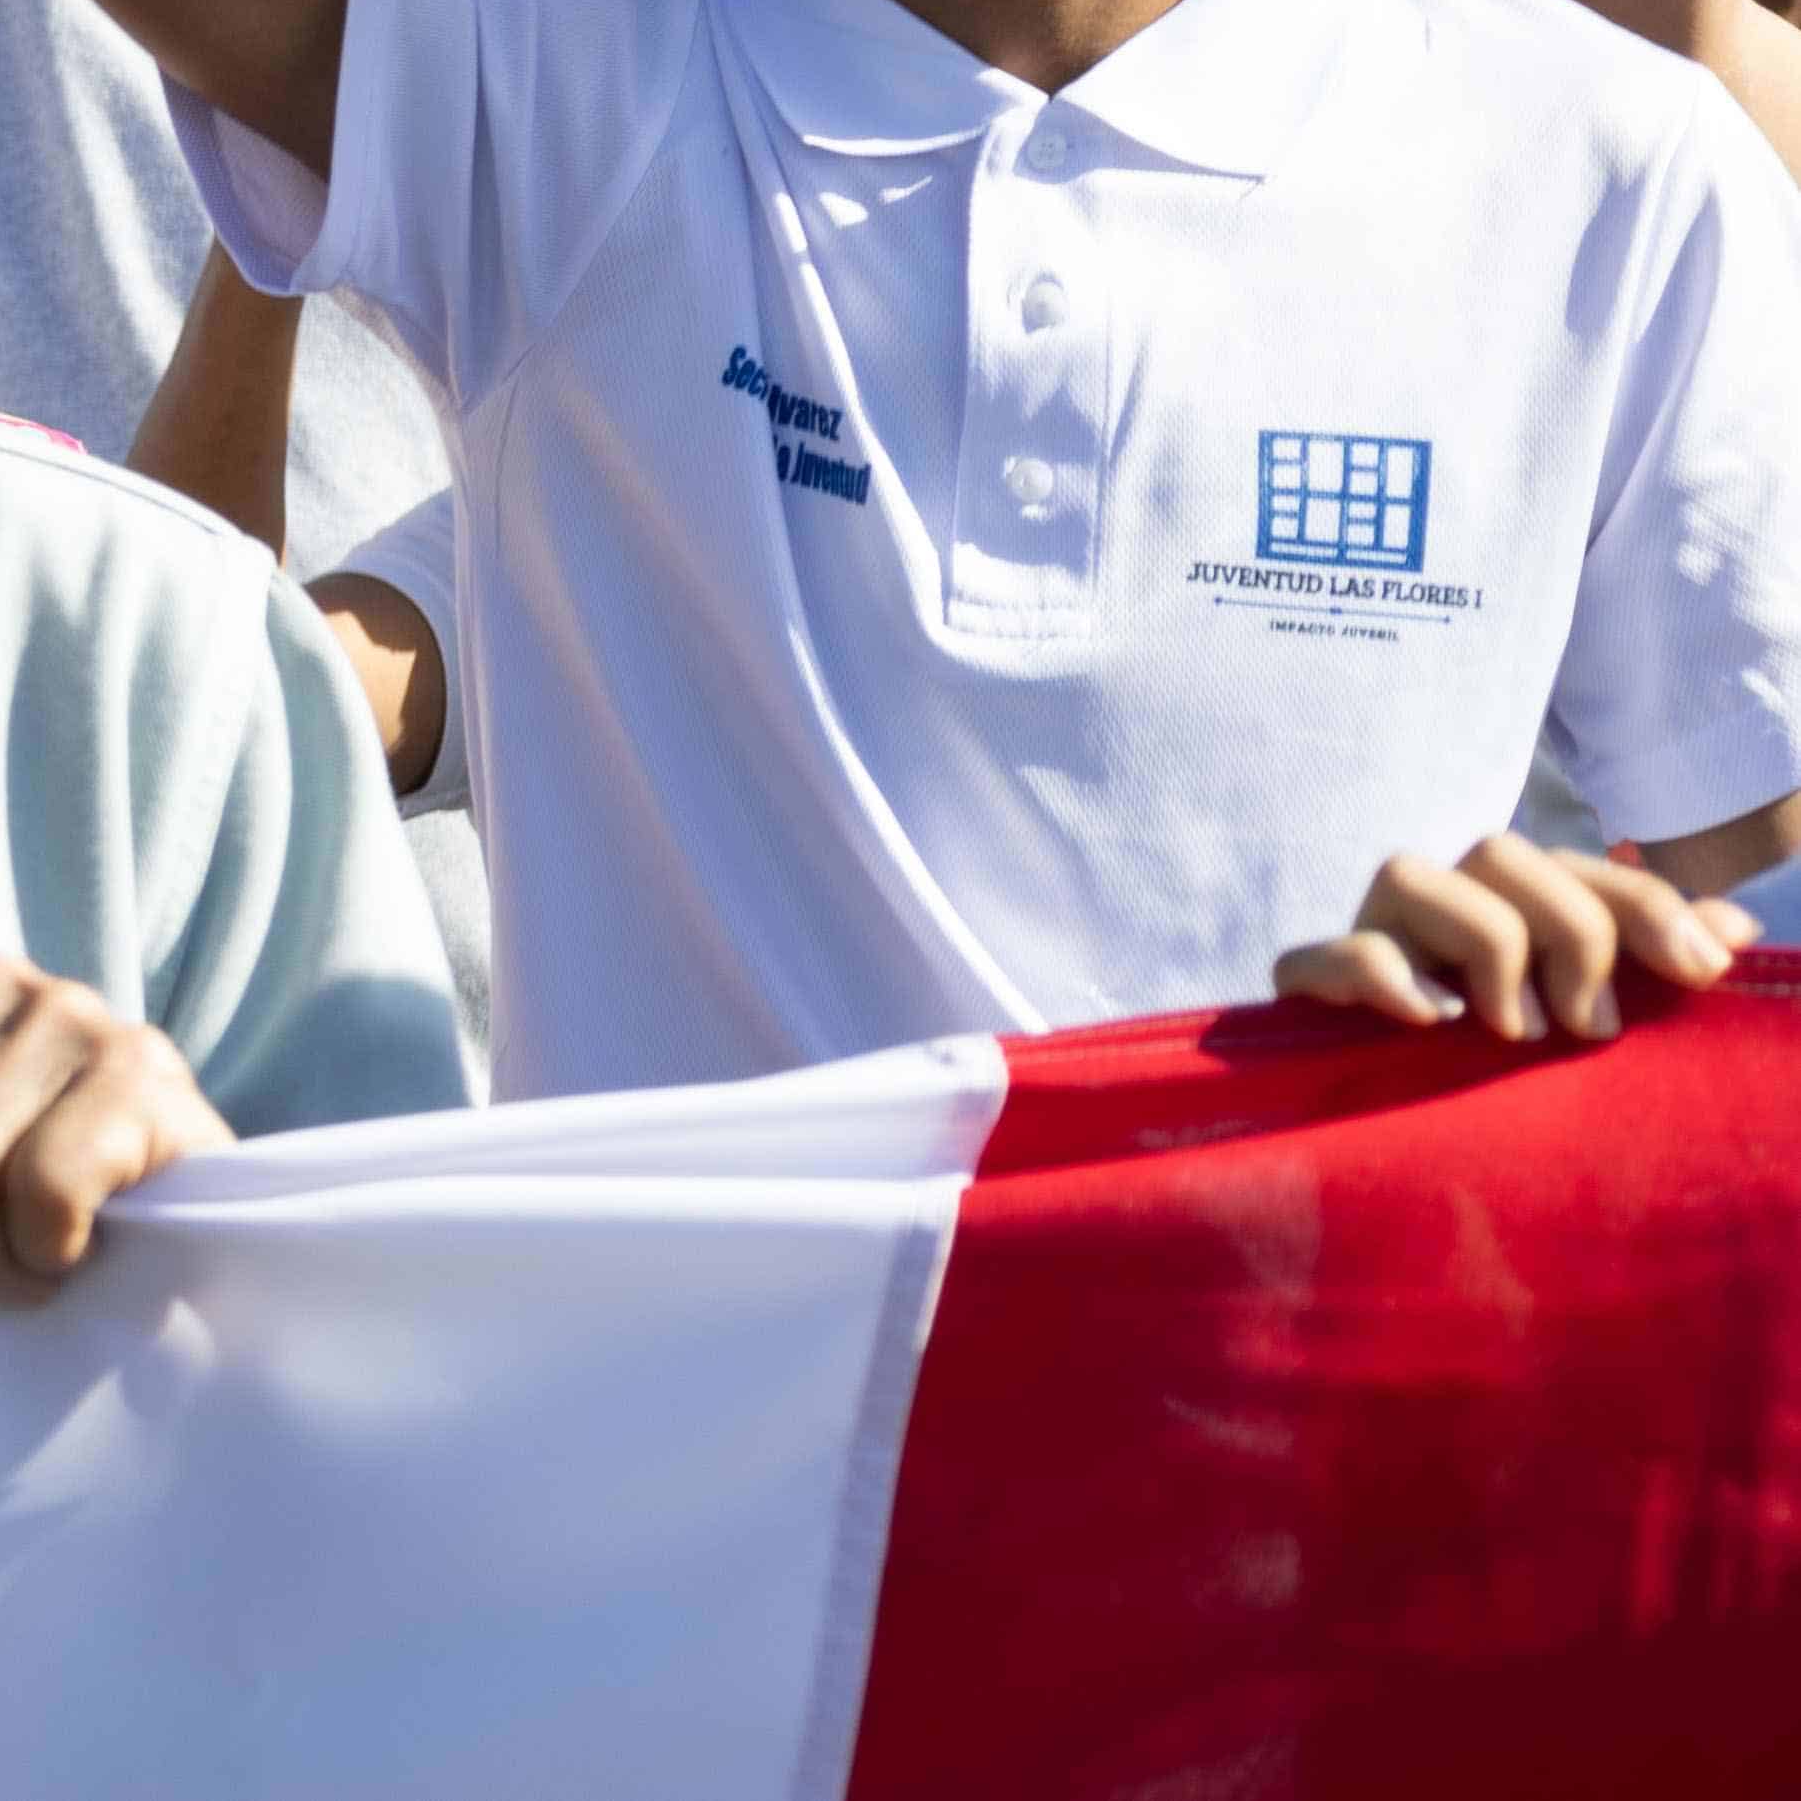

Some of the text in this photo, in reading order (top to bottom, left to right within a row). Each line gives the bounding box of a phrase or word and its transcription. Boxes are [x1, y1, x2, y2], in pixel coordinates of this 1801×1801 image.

[1187, 562, 1324, 595] JUVENTUD
[1329, 573, 1376, 600] LAS
[1380, 578, 1469, 607] FLORES
